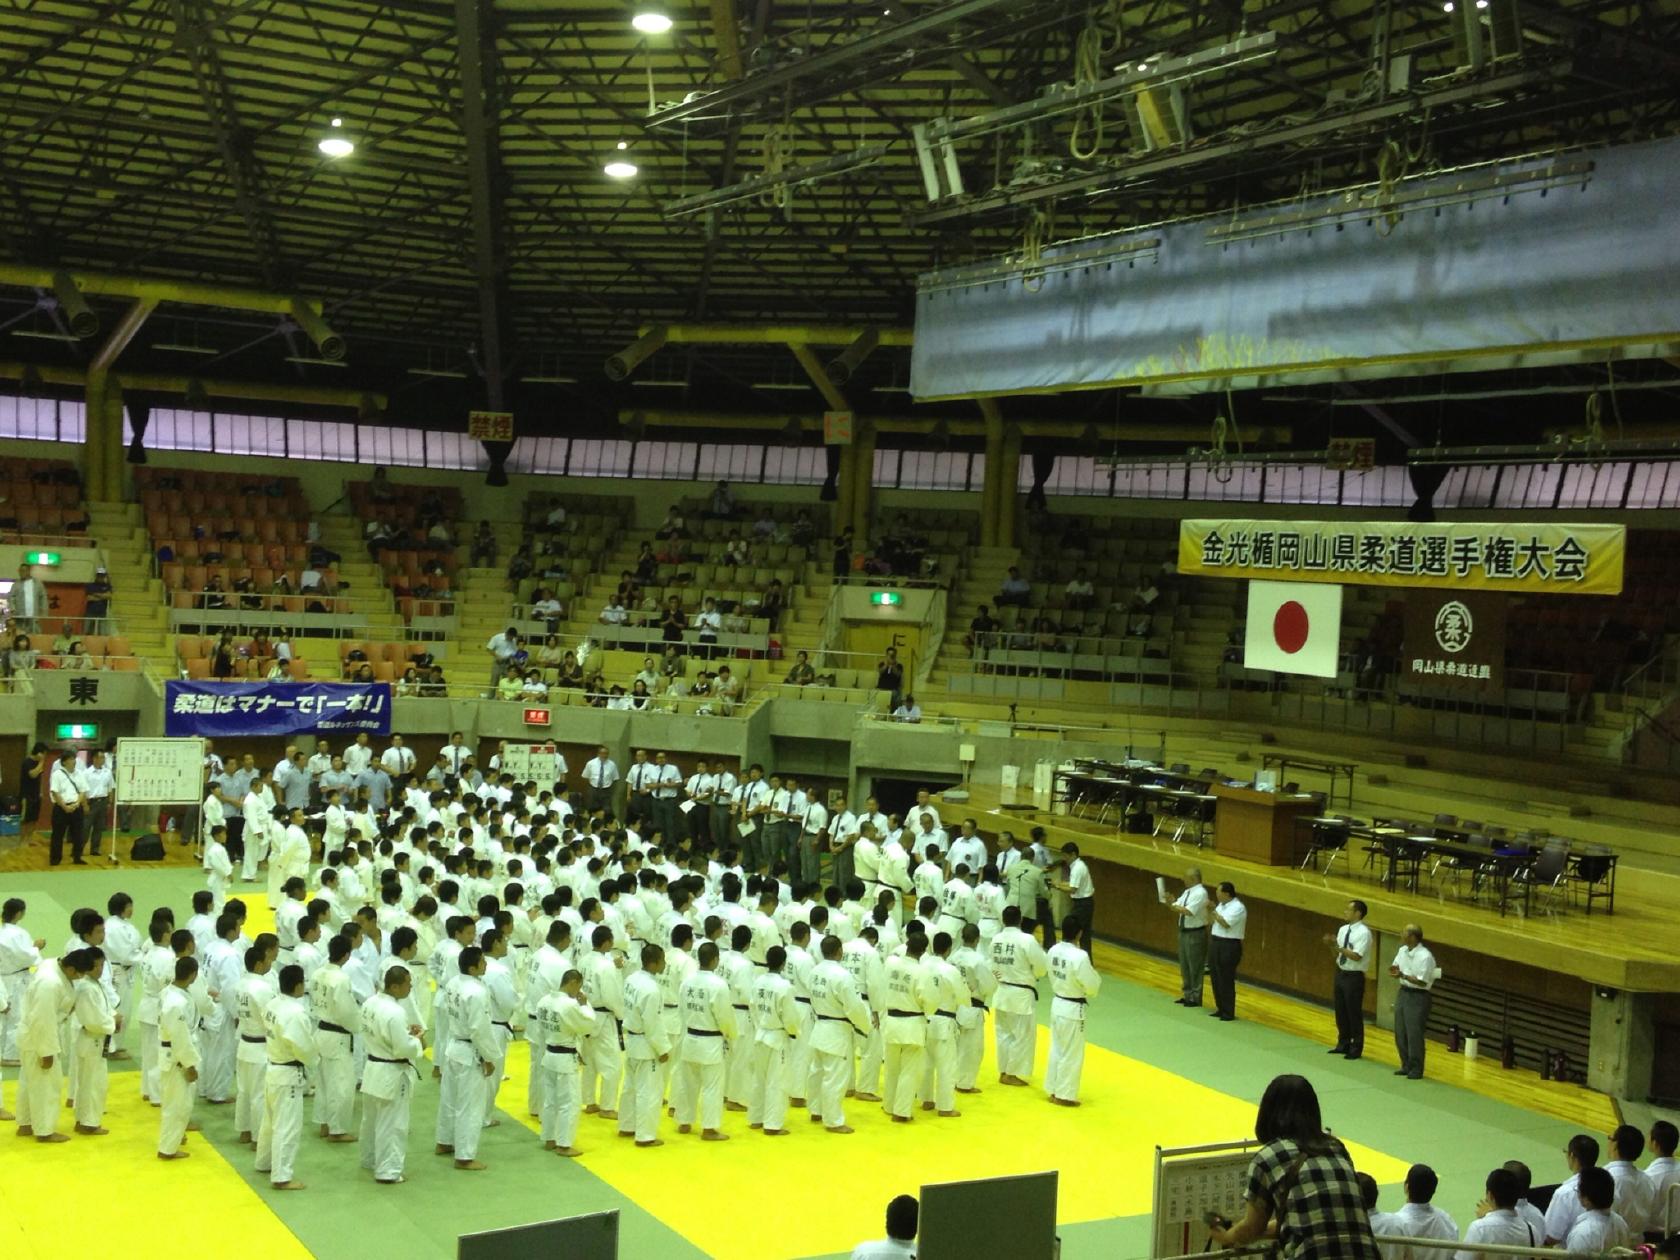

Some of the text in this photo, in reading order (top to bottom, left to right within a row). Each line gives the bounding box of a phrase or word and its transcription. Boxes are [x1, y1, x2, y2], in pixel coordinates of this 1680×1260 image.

[472, 415, 513, 439] 禁煙
[1201, 530, 1588, 582] 金光楯岡山県柔道選手権大会
[1412, 659, 1490, 679] 岡山県柔道連盟
[69, 677, 99, 705] 東
